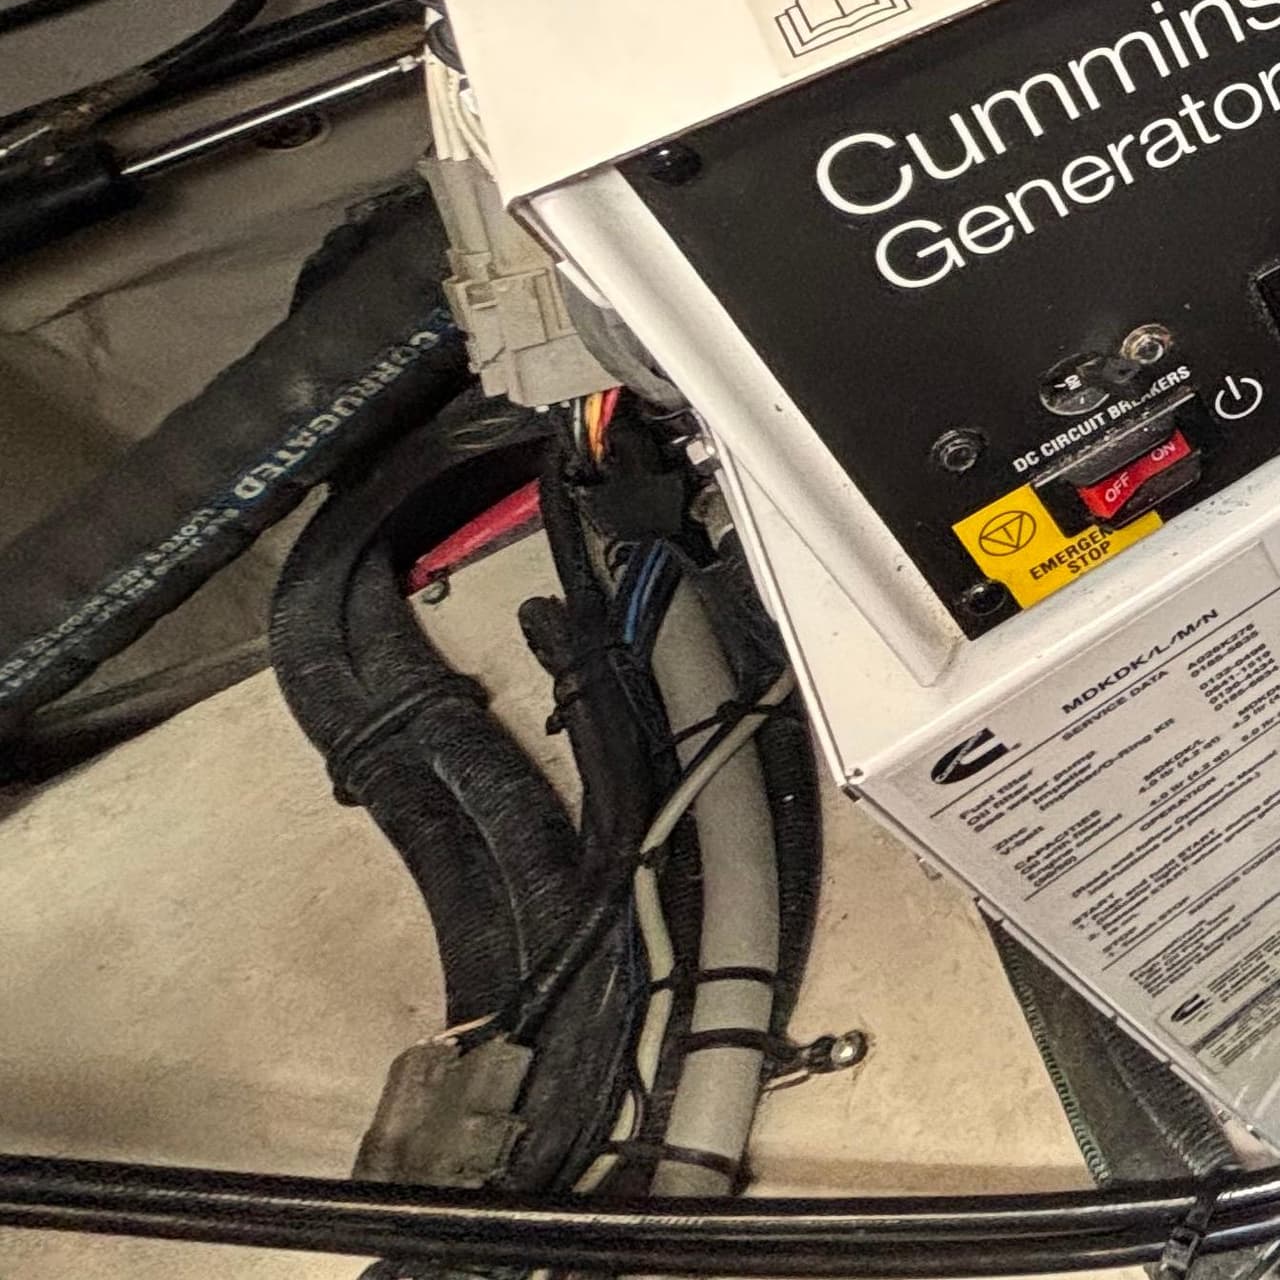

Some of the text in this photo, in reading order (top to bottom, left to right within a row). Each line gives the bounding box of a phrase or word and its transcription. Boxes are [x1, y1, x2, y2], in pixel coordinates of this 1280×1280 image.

[1012, 451, 1040, 473] DC
[1040, 415, 1107, 458] CIRCUIT
[1104, 442, 1178, 504] OFF ON
[1066, 540, 1111, 575] STOP
[1060, 608, 1219, 714] MDKDK/L/M/N
[1061, 670, 1169, 741] SERVICE DATA
